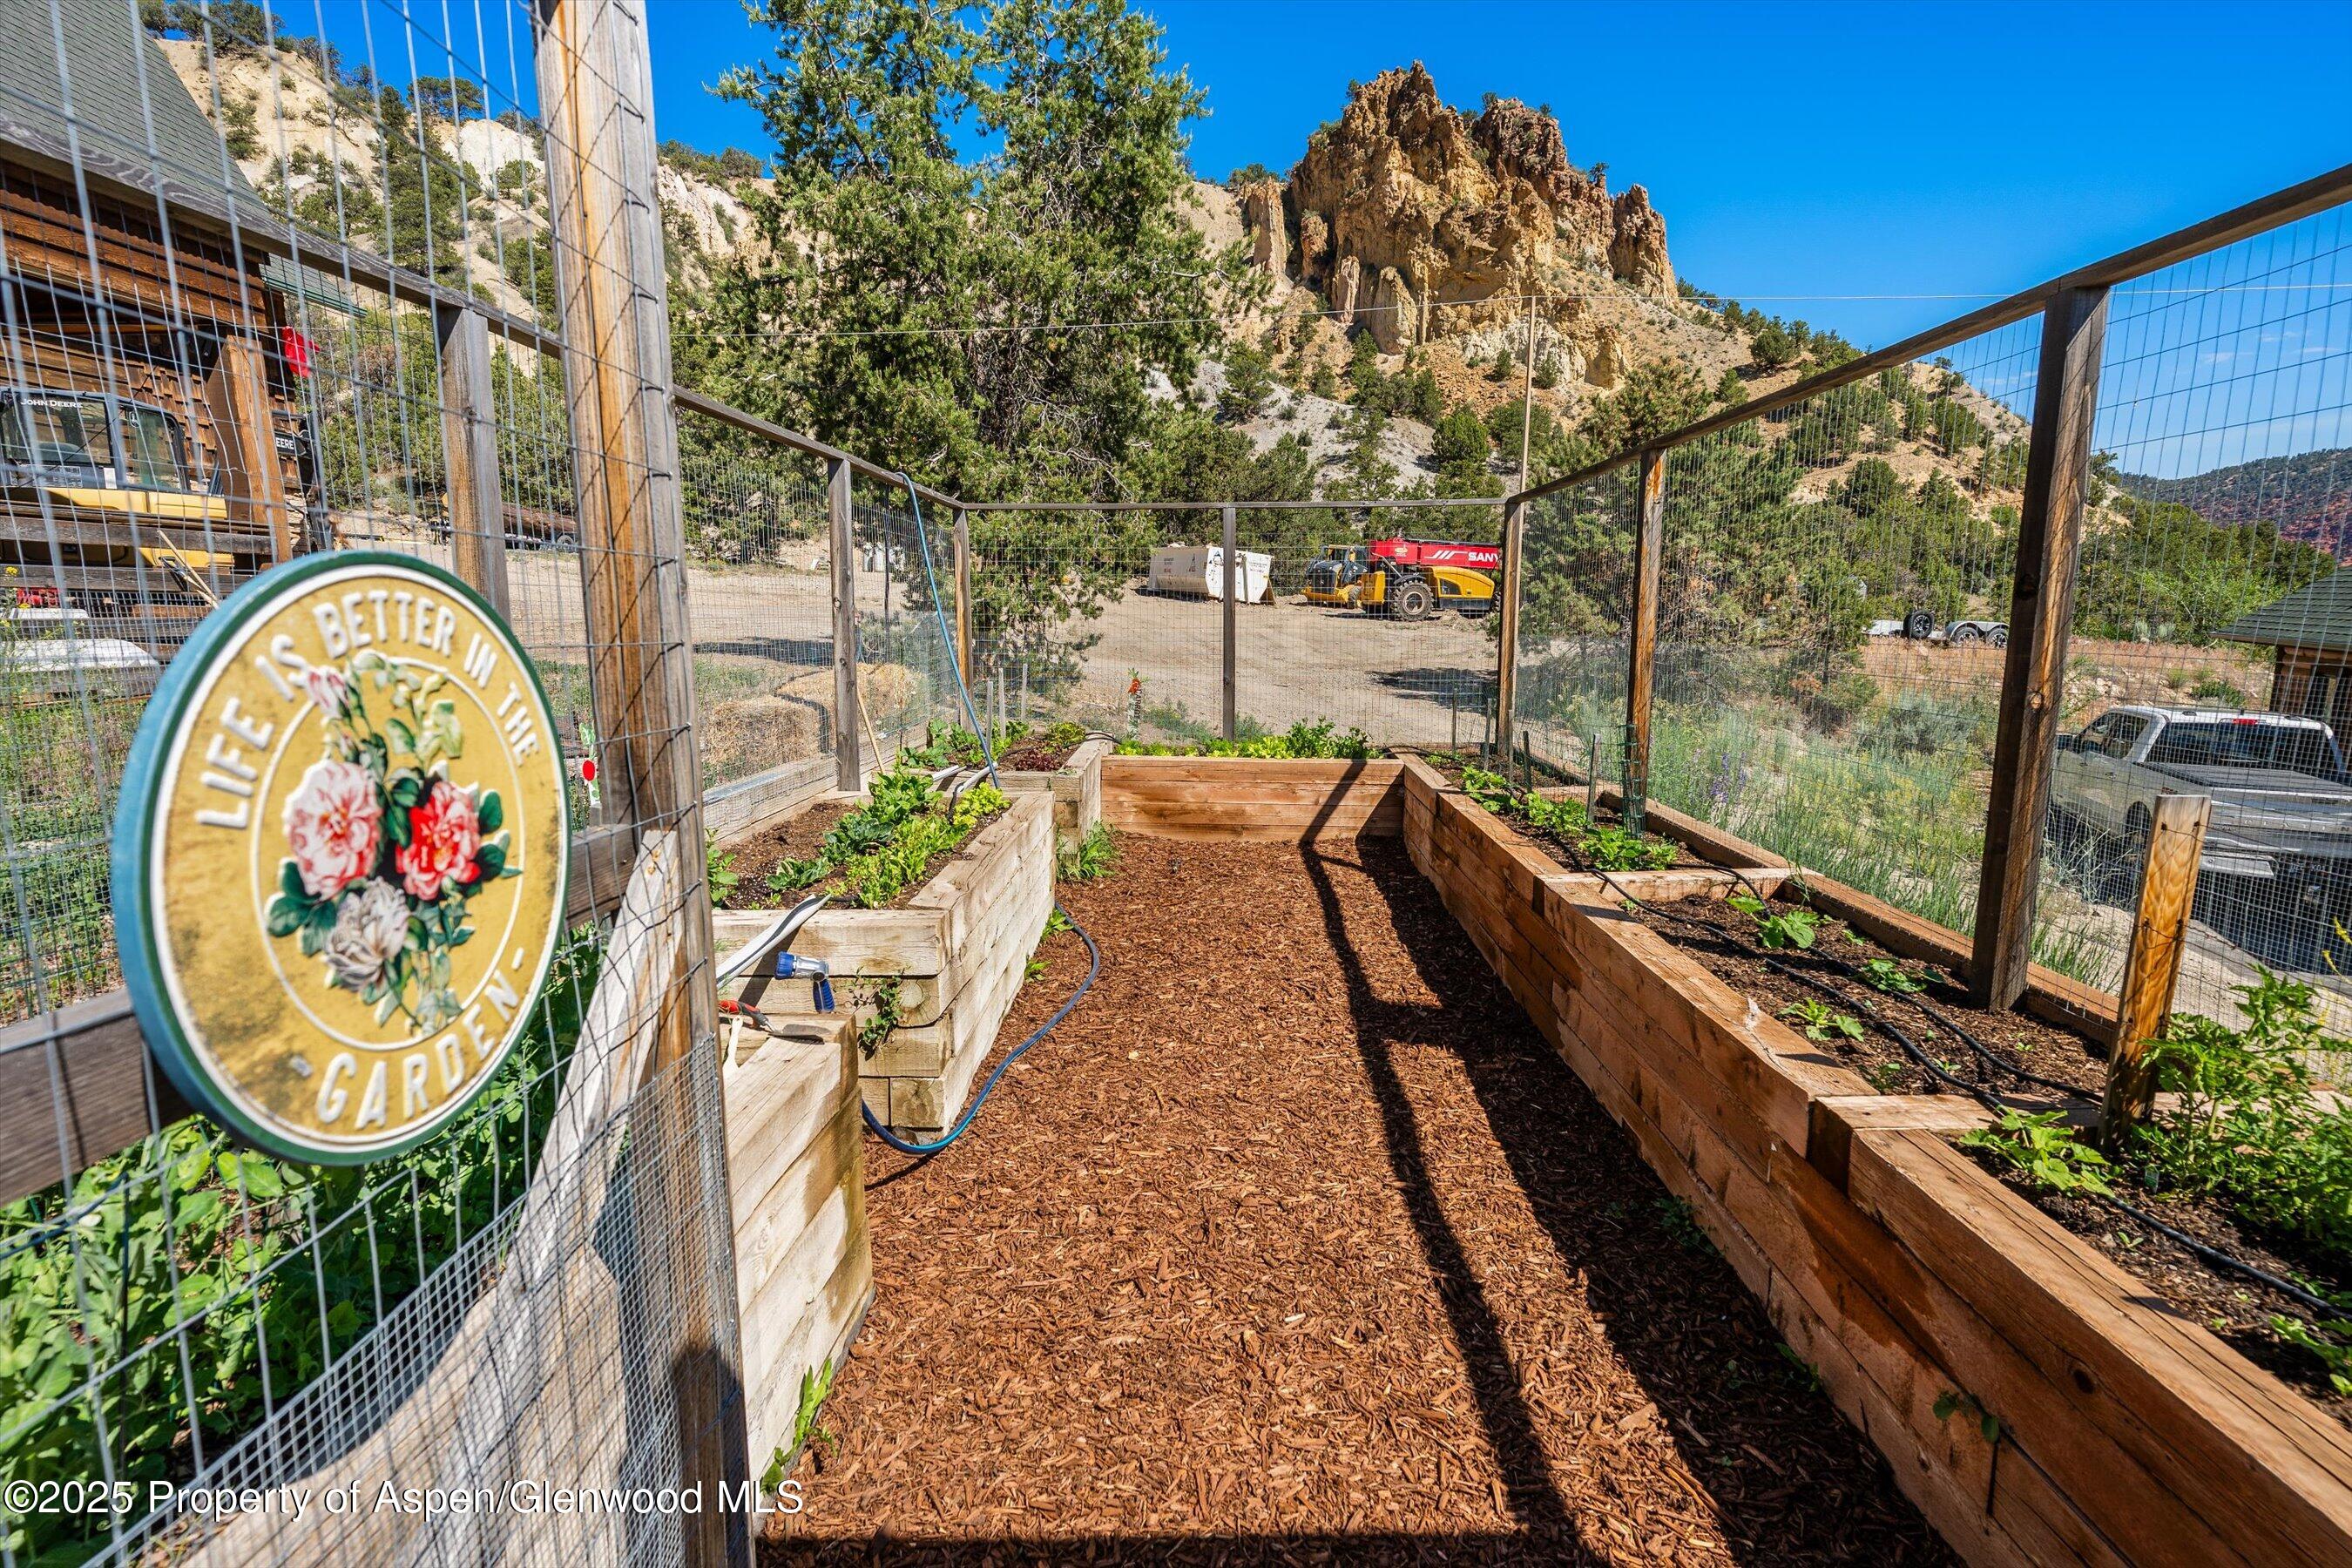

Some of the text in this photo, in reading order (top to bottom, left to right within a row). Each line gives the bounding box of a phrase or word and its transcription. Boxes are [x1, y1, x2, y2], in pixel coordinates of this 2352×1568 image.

[49, 400, 84, 409] DEERE
[275, 436, 294, 450] EERE
[194, 589, 540, 830] LIFE IS BETTER IN THE
